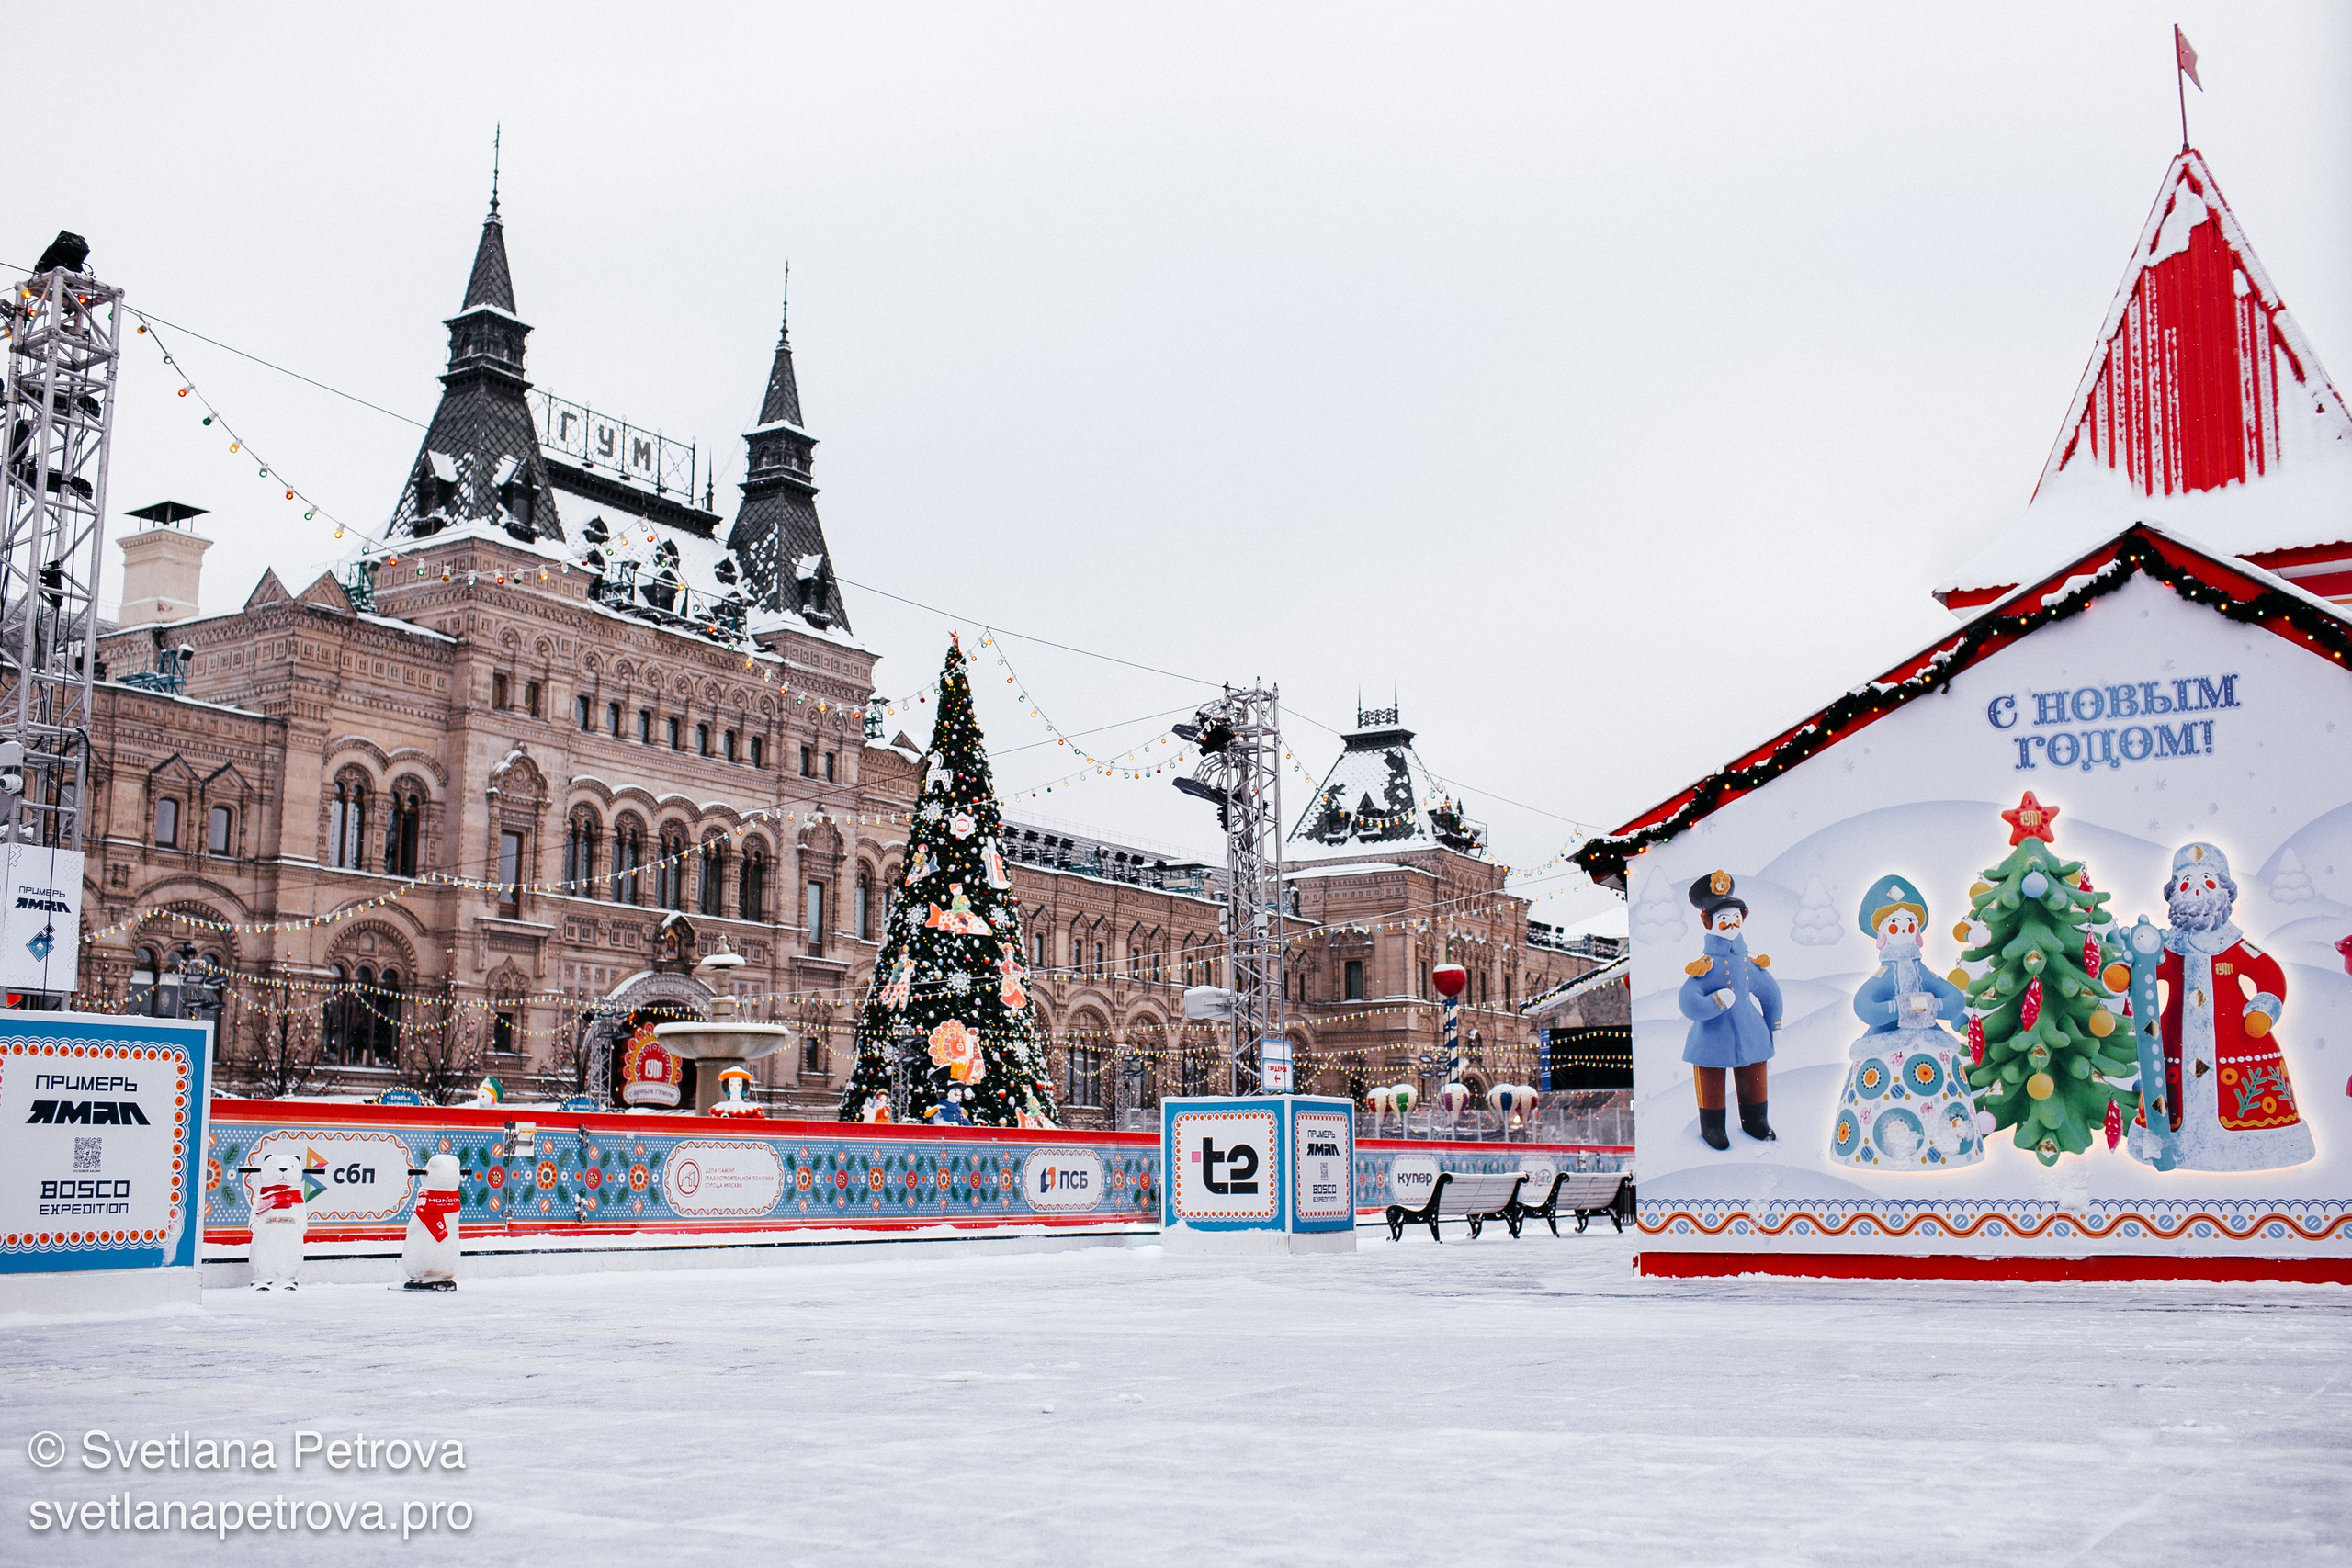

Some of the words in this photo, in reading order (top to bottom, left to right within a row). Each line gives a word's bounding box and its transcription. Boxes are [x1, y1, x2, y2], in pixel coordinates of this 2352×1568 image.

[560, 411, 651, 471] ГУМ
[1987, 695, 2018, 729] С
[2032, 674, 2241, 725] НОВЫМ
[2013, 720, 2215, 772] ГОДОМ!
[18, 886, 66, 898] ПРИМЕРЬ
[15, 897, 72, 914] ЯМАЛ
[35, 1074, 138, 1092] ПРИМЕРЬ
[25, 1100, 152, 1126] ЯМАЛ
[1307, 1129, 1336, 1139] ПРИМЕРЬ
[1306, 1143, 1340, 1156] ЯМАЛ
[333, 1162, 376, 1185] сбп
[1203, 1136, 1259, 1195] t2
[40, 1179, 130, 1200] BOSCO
[1059, 1170, 1089, 1190] ПСБ
[1312, 1184, 1337, 1194] BOSCO
[39, 1202, 130, 1216] EXPEDITION
